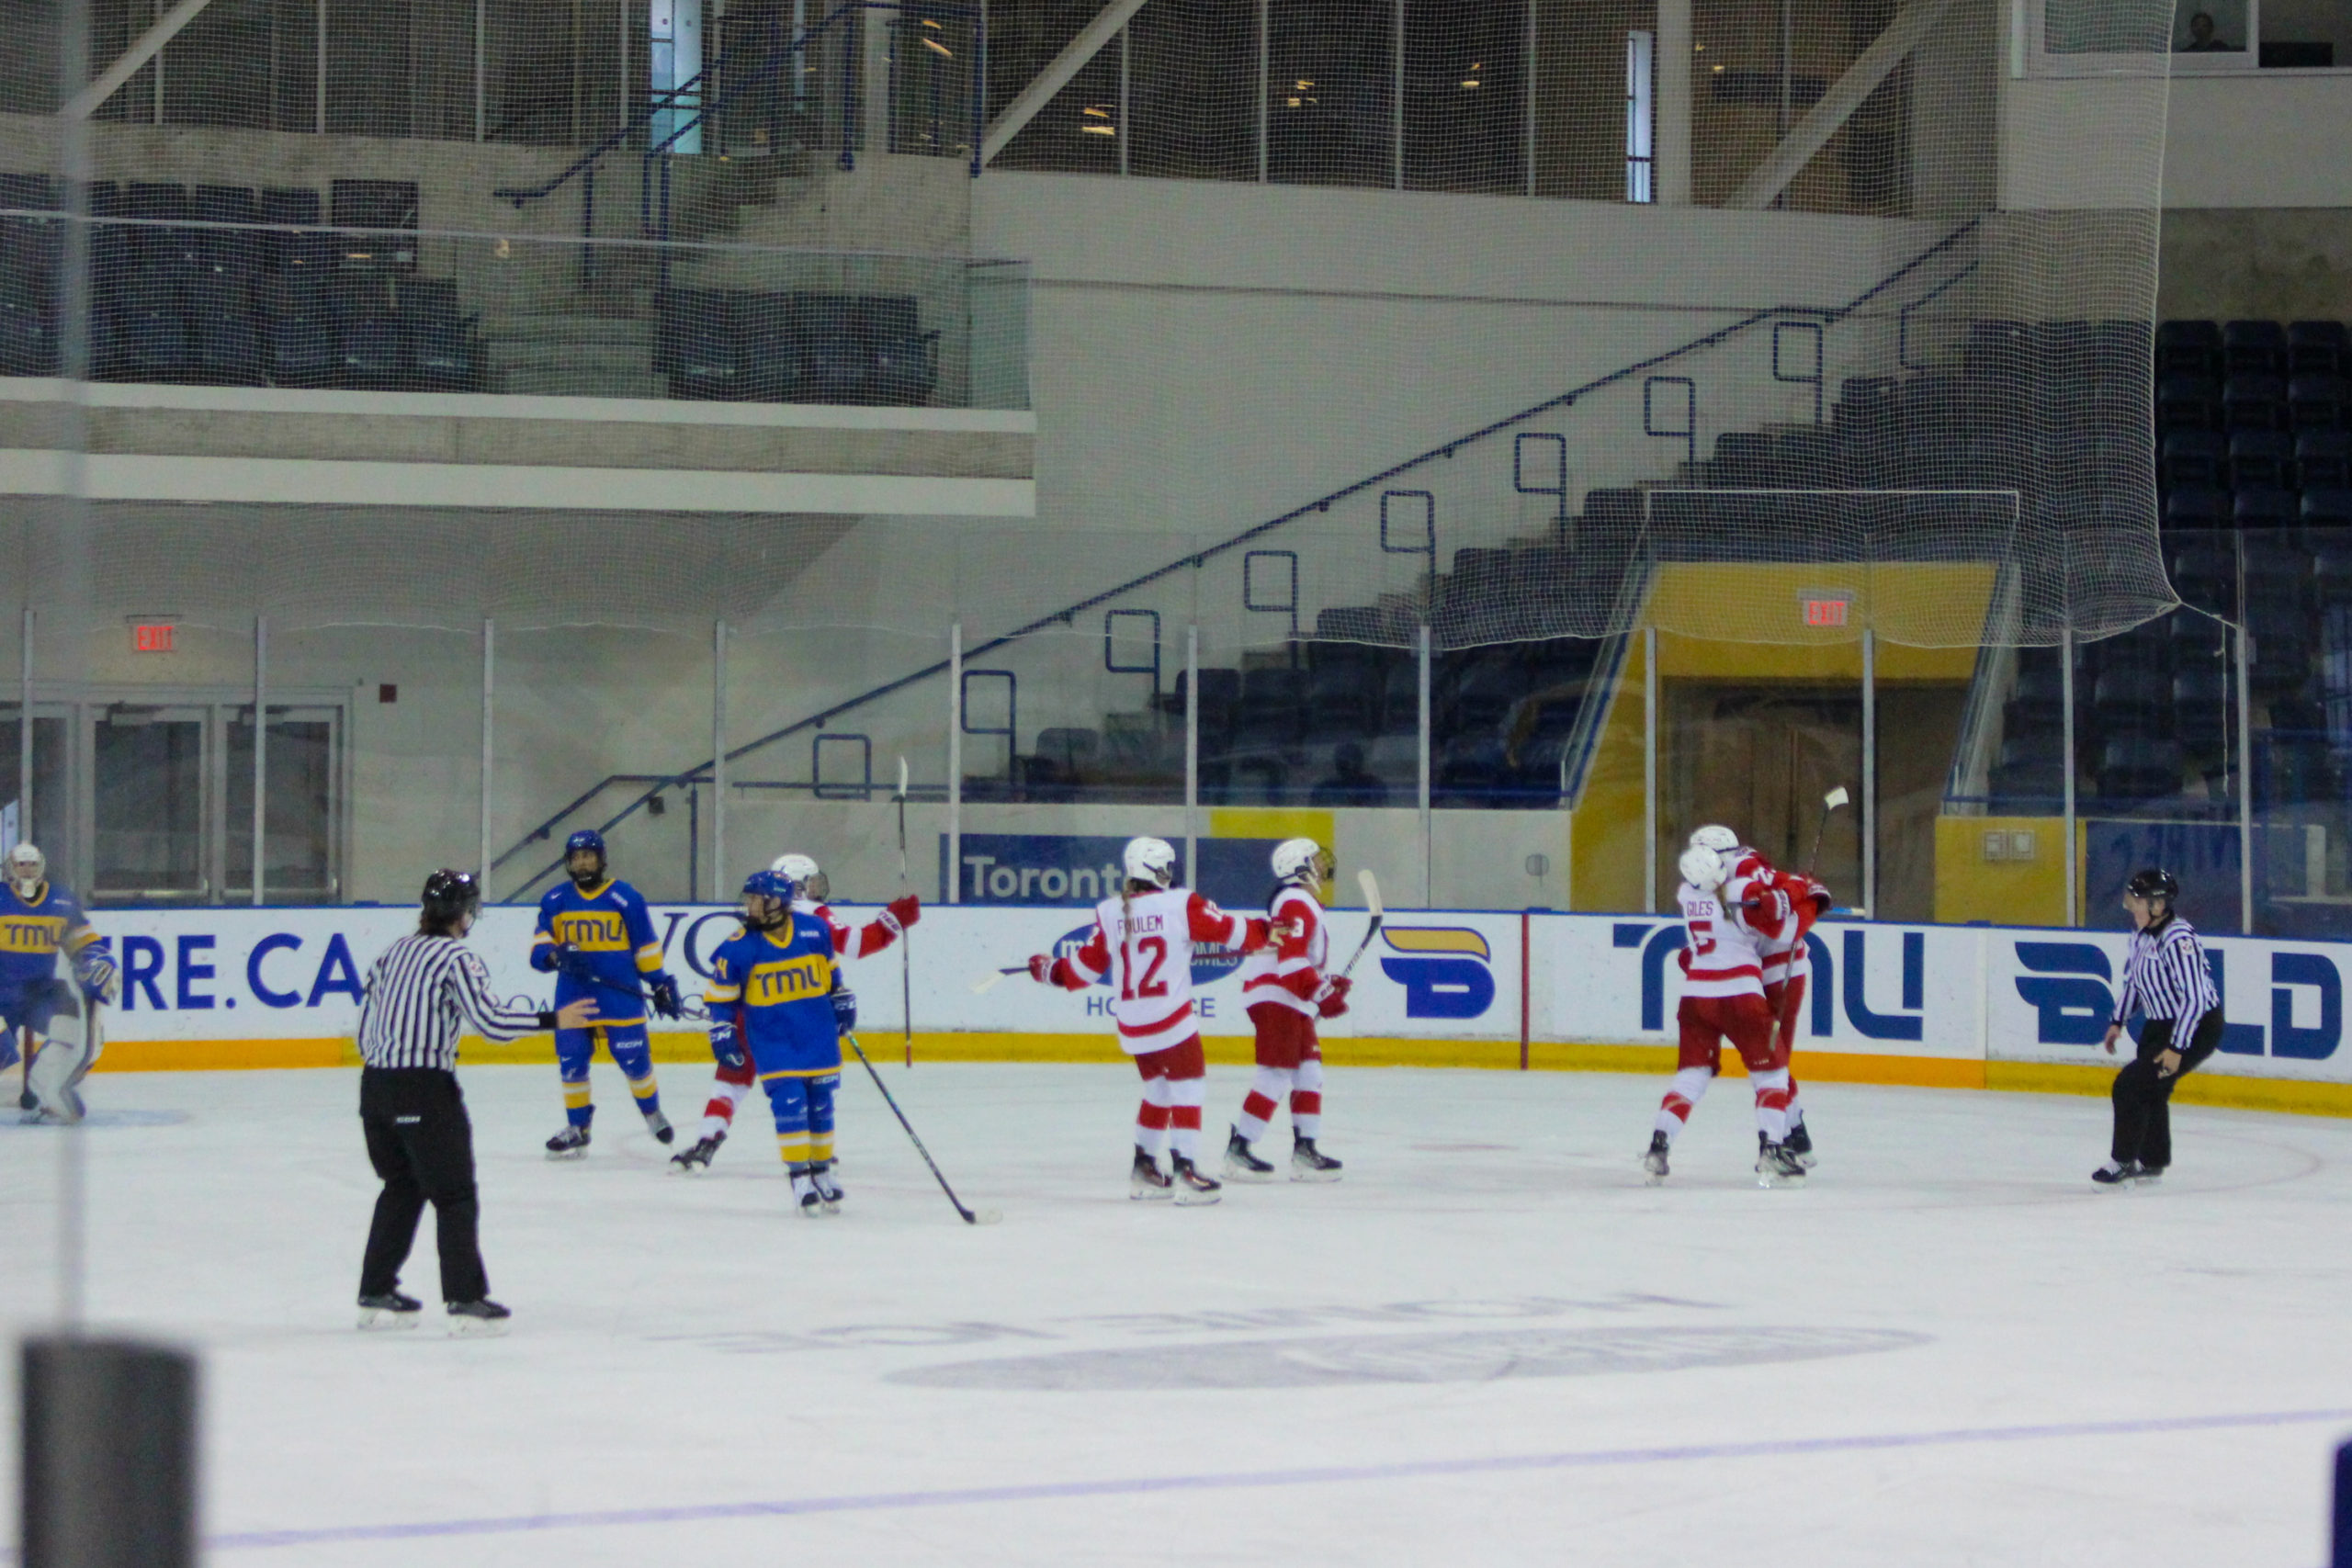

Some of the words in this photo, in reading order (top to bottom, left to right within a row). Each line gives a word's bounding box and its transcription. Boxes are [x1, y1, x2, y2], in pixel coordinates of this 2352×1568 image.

[1807, 601, 1845, 625] EXIT
[137, 626, 174, 650] EXIT
[963, 856, 1128, 897] Toront
[1686, 900, 1713, 917] GILES
[1117, 914, 1164, 935] FULEM
[1689, 920, 1716, 955] 5
[1119, 936, 1168, 1001] 12
